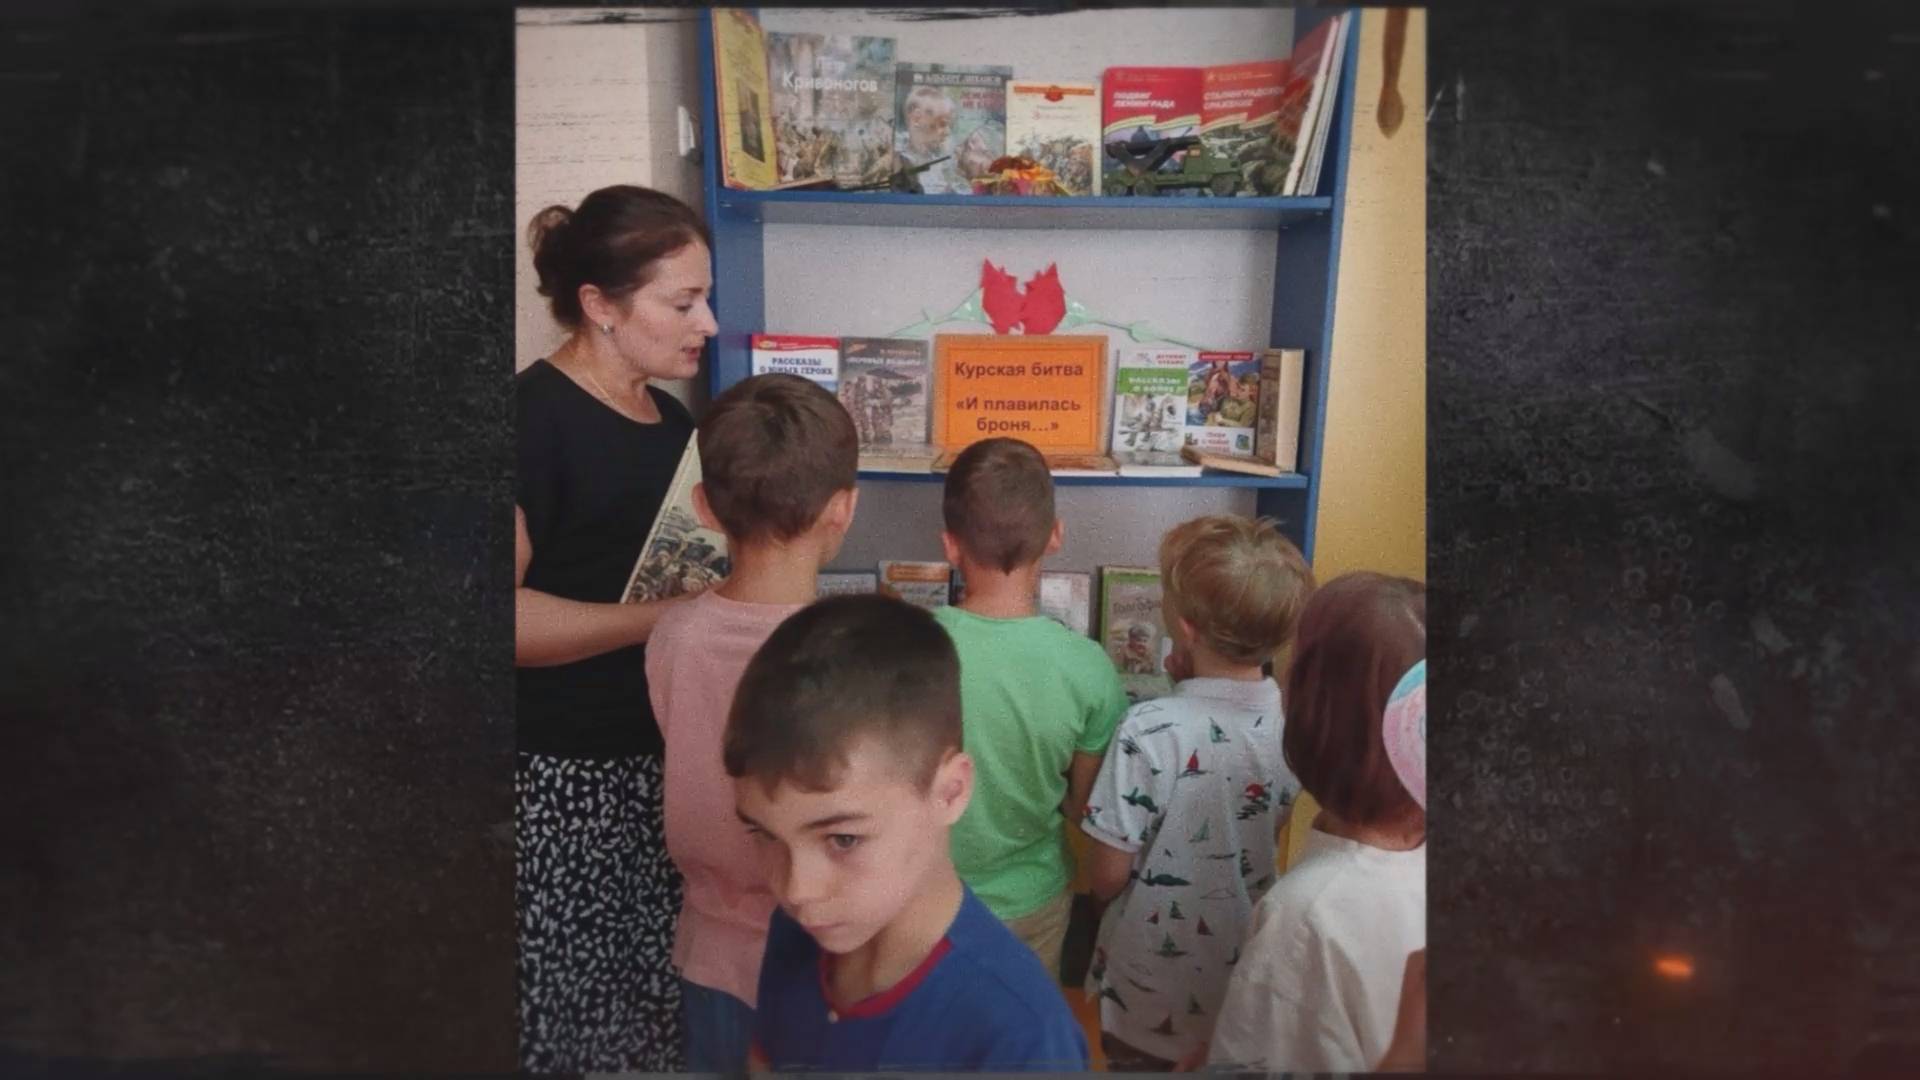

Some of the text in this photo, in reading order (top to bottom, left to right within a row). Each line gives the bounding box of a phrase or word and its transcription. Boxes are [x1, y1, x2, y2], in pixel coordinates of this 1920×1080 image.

[782, 70, 878, 93] Кривоногов
[1112, 91, 1153, 100] ПОДВИГ
[1112, 99, 1177, 110] ЛЕНИНГРАДА
[772, 356, 822, 366] РАССКАЗЫ
[760, 365, 833, 376] О ЮНЫХ ГЕРОЯХ
[954, 361, 1084, 379] Курская битва
[955, 395, 1081, 412] «И плавилась
